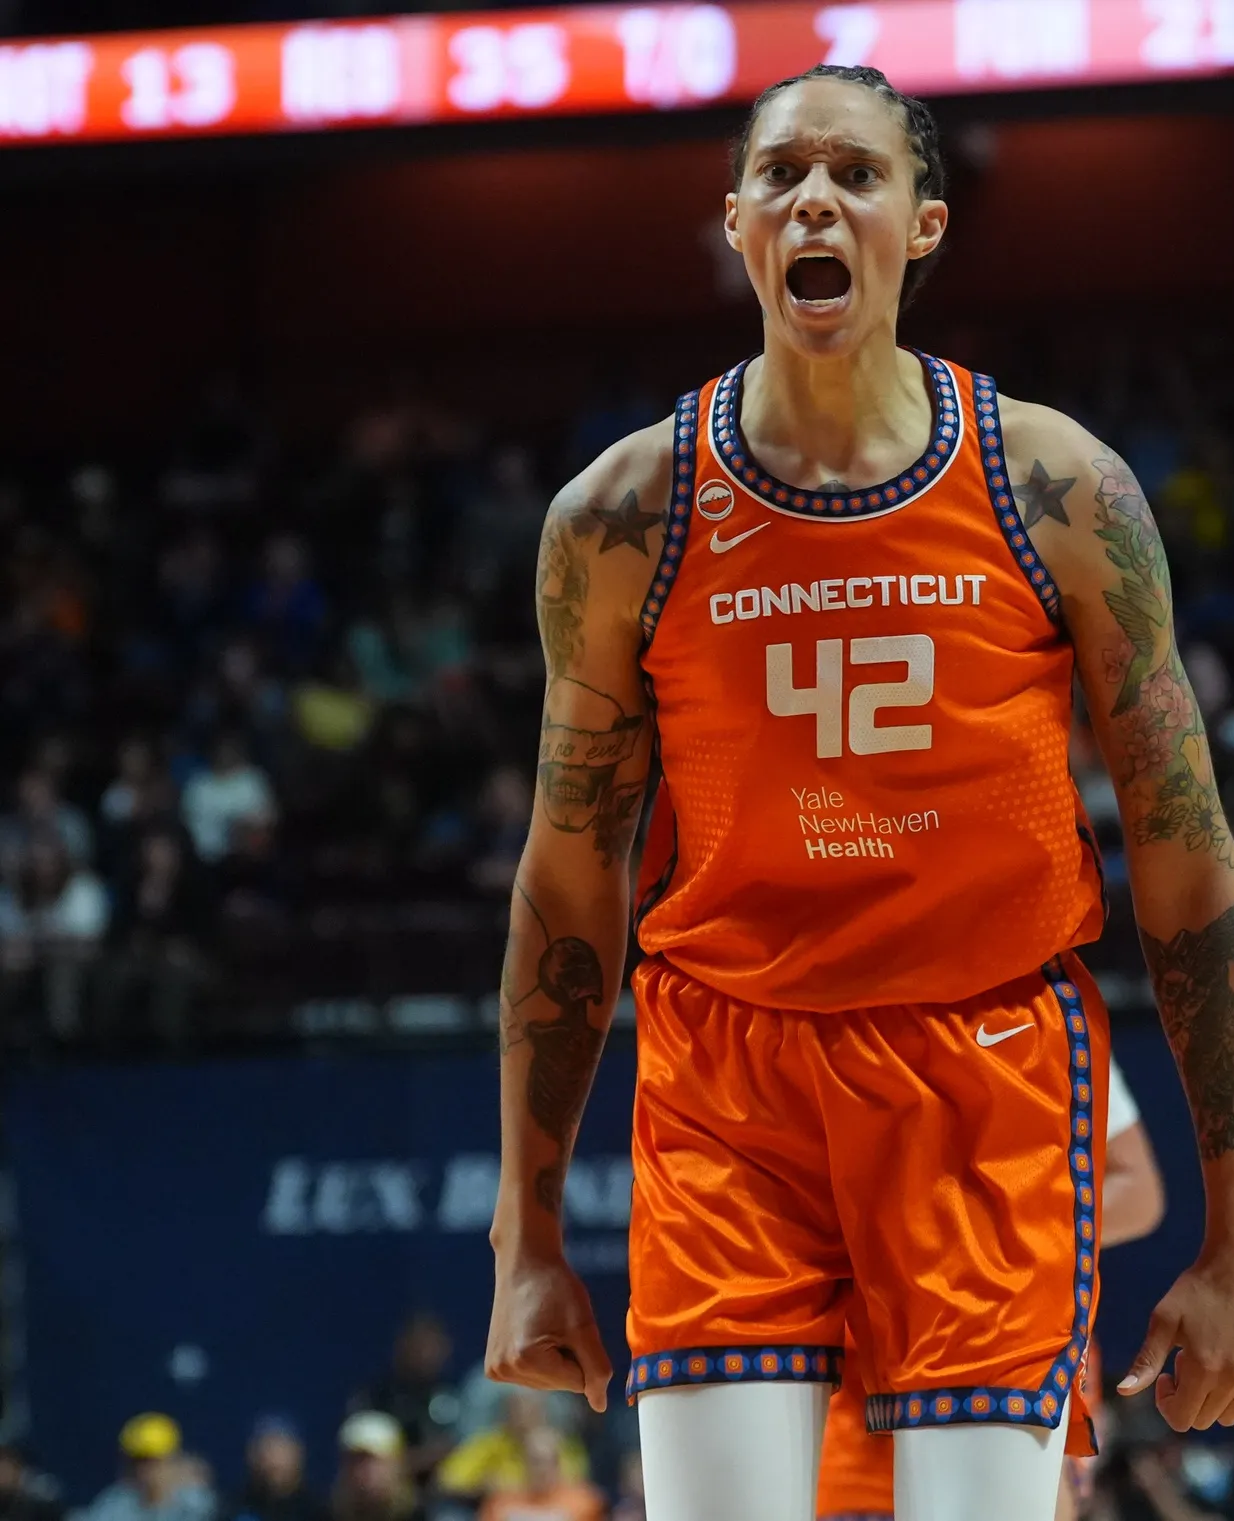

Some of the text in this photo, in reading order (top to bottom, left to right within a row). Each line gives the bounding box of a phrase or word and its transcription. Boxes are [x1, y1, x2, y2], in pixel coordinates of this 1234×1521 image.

[126, 44, 233, 126] 13
[449, 25, 567, 108] 35
[709, 574, 987, 625] CONNECTICUT
[765, 633, 935, 759] 42
[790, 787, 844, 811] Yale
[798, 808, 940, 836] NewHaven
[804, 836, 895, 860] Health
